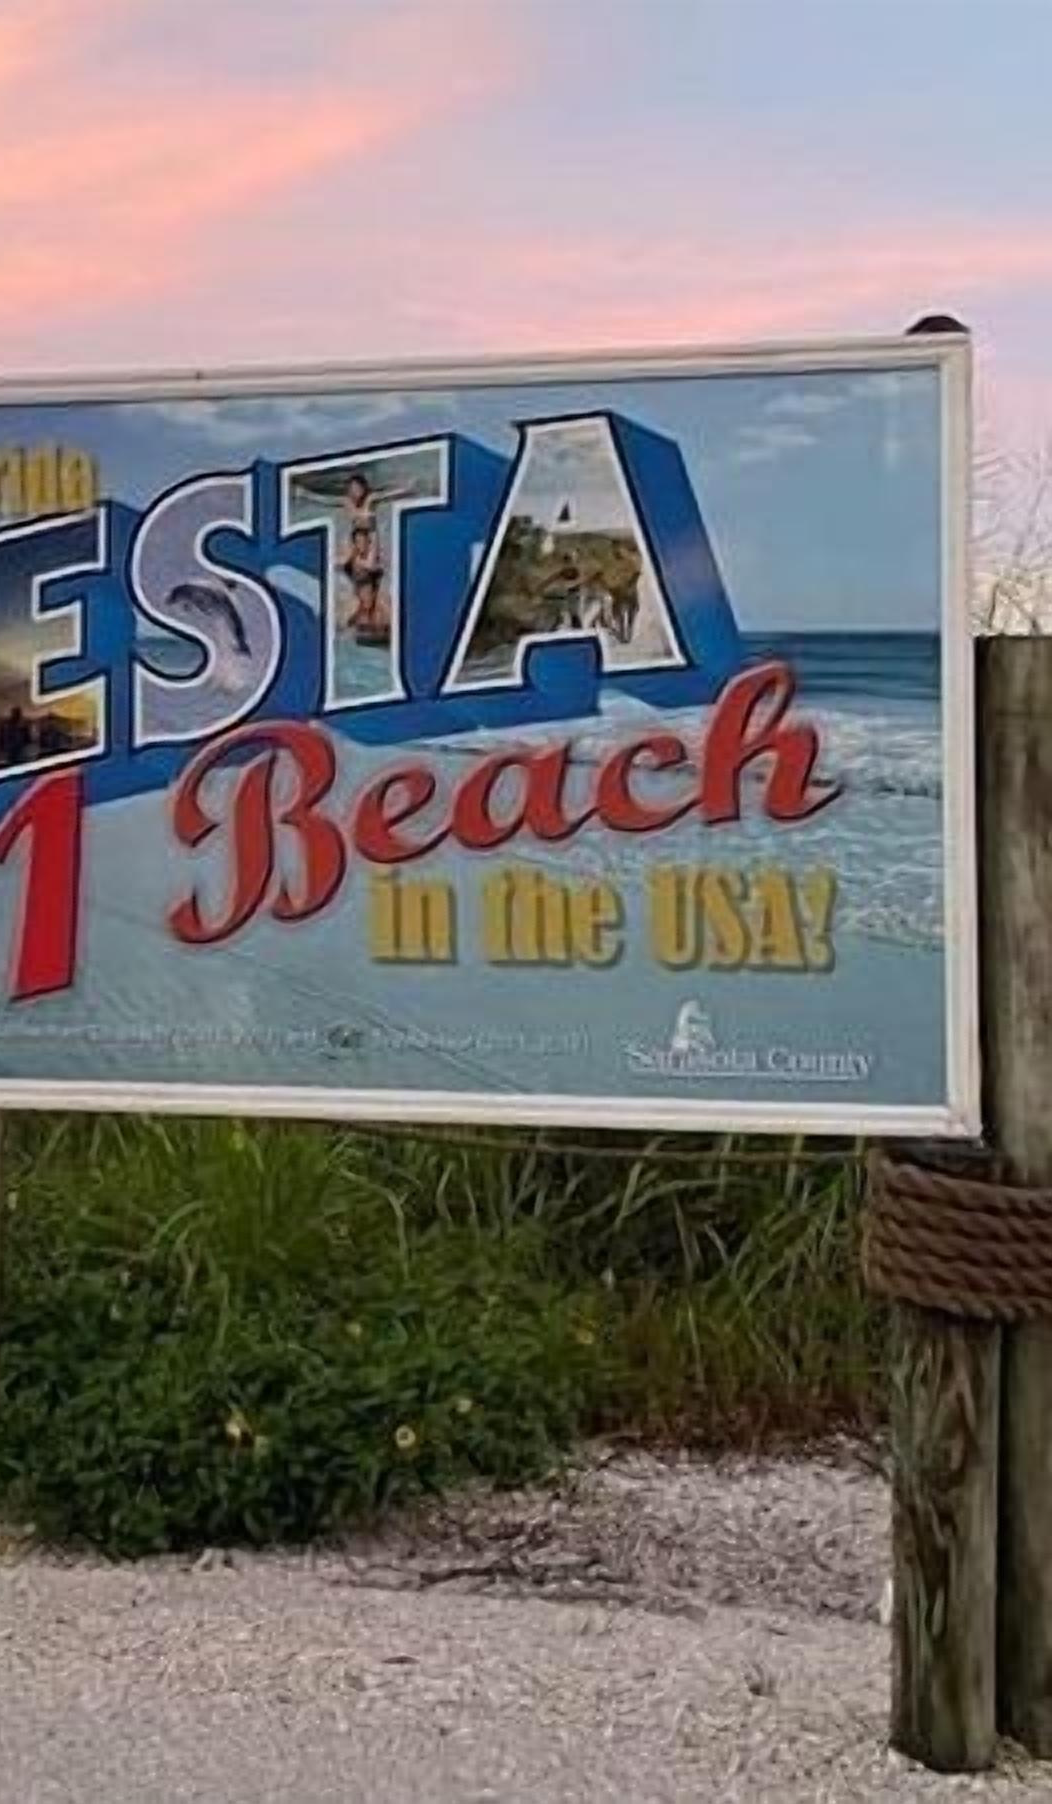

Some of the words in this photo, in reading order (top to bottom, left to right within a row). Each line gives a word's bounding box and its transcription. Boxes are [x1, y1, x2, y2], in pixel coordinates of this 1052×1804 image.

[167, 660, 842, 944] Beach
[370, 868, 456, 965] in
[482, 868, 624, 968] the
[652, 864, 837, 972] USA!
